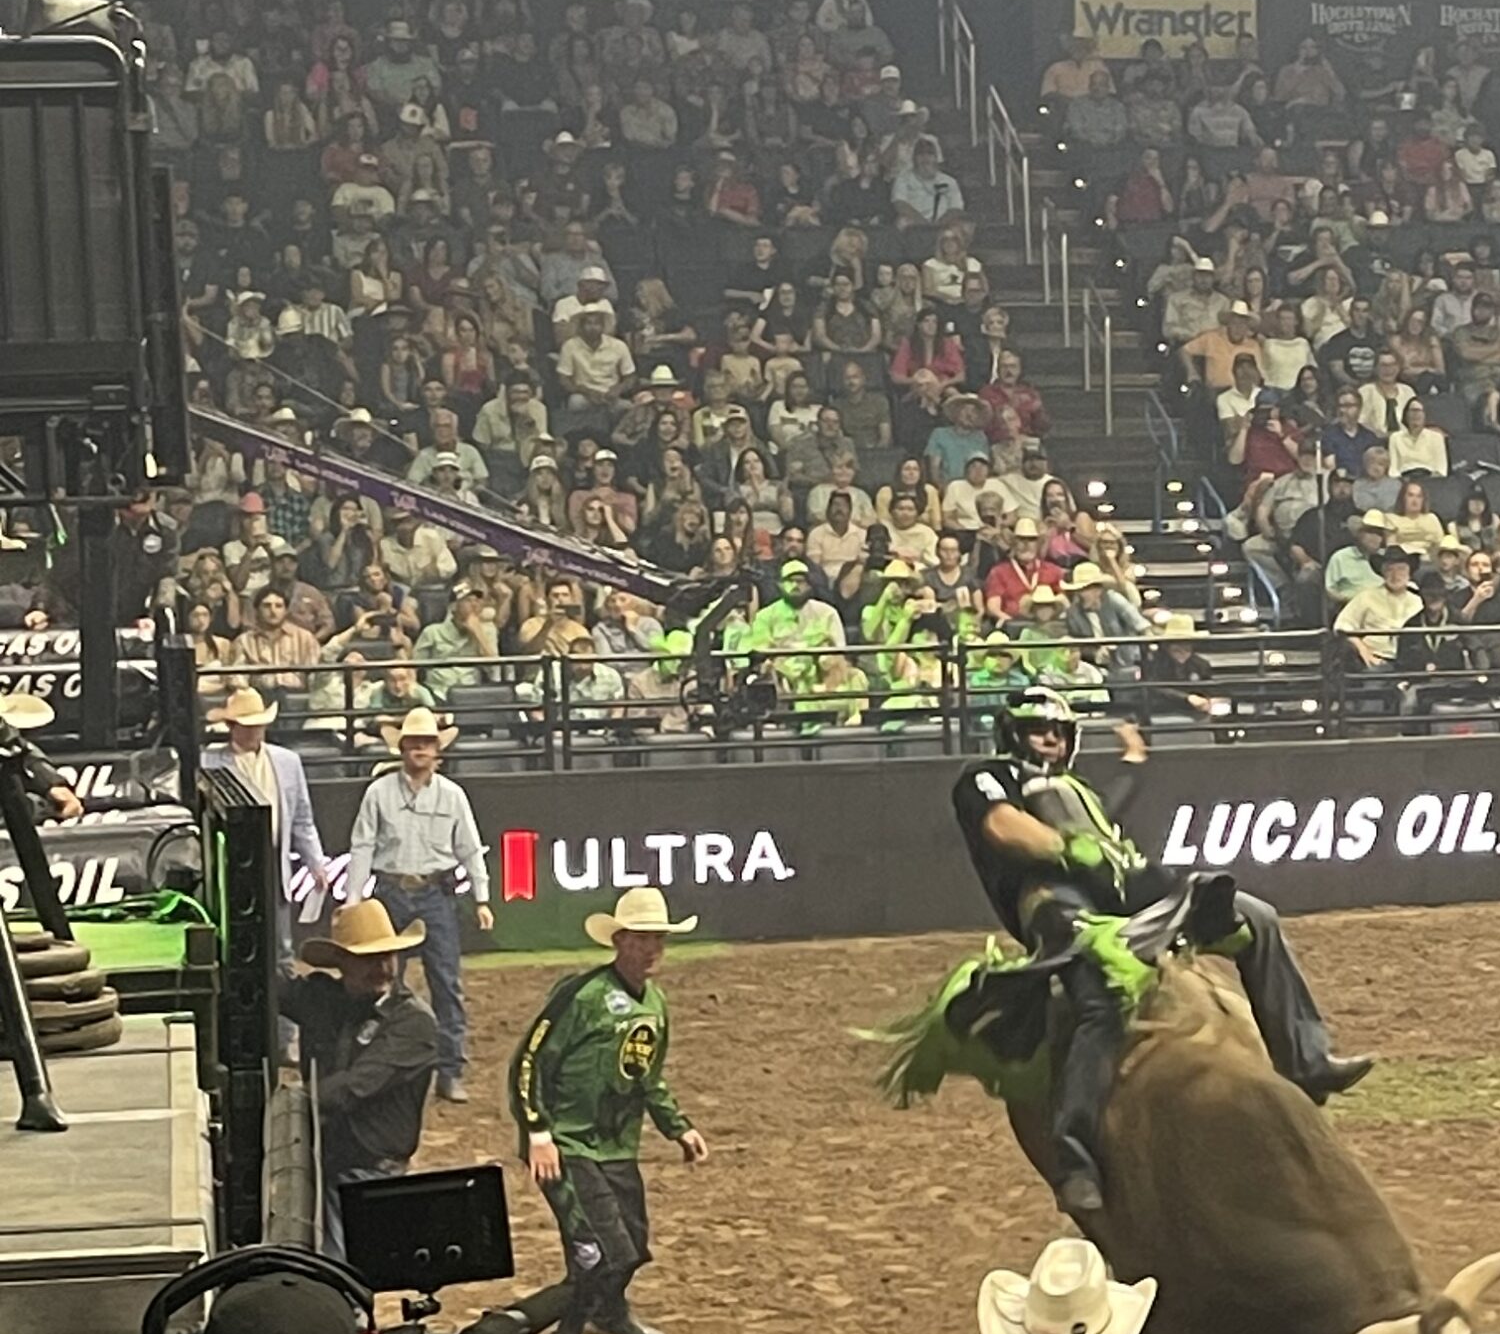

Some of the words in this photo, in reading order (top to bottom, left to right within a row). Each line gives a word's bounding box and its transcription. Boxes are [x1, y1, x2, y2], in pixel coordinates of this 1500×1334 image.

[1080, 1, 1254, 40] Wrangler
[552, 829, 795, 891] ULTRA
[1162, 797, 1383, 865] LUCAS
